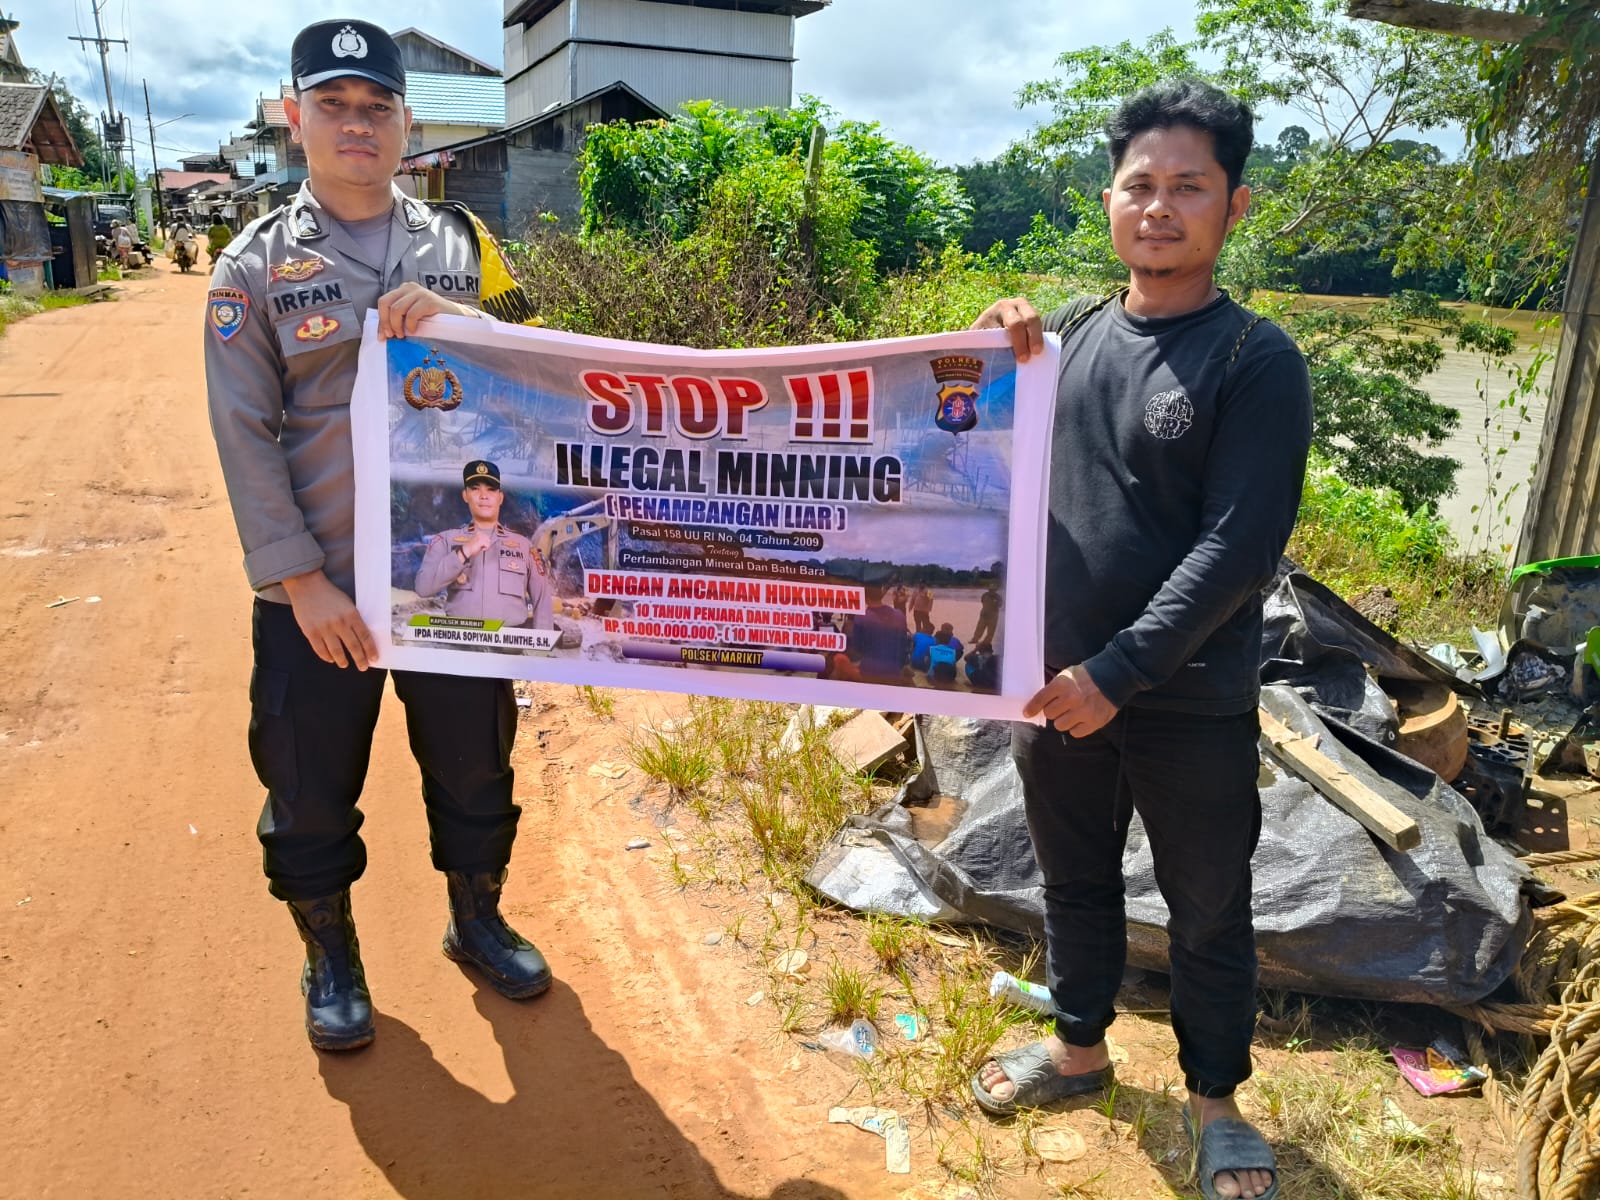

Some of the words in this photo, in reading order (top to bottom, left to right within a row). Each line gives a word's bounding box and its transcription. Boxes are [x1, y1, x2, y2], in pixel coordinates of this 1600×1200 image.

[425, 273, 479, 294] POLRI
[273, 283, 342, 315] IRFAN
[937, 357, 977, 366] POLRES
[580, 370, 767, 438] STOP
[556, 443, 706, 493] ILLEGAL
[716, 451, 901, 502] MINNING
[632, 526, 660, 537] Pasal
[664, 529, 681, 539] 158
[684, 531, 700, 540] UU
[704, 532, 714, 541] RI
[718, 533, 735, 543] No.
[740, 533, 752, 543] 04
[756, 535, 790, 545] Tahun
[793, 537, 819, 547] 2009
[623, 553, 702, 568] Pertambangan
[705, 558, 744, 570] Mineral
[747, 560, 768, 571] Dan
[771, 563, 796, 575] Batu
[799, 565, 825, 576] Bara
[588, 573, 664, 598] DENGAN
[667, 578, 760, 603] ANCAMAN
[765, 583, 860, 610] HUKUMAN
[636, 603, 650, 618] 10
[652, 605, 691, 620] TAHUN
[694, 606, 744, 623] PENJARA
[747, 609, 770, 624] DAN
[772, 611, 811, 628] DENDA
[414, 628, 432, 639] IPDA
[433, 629, 461, 641] HENDRA
[463, 631, 493, 644] SOPIYAN
[494, 633, 502, 644] D.
[503, 634, 535, 648] MUNTHE,
[536, 636, 551, 647] S.H.
[604, 619, 621, 633] RP.
[748, 629, 790, 645] MILYAR
[681, 648, 718, 662] POLSEK
[720, 650, 763, 665] MARIKIT
